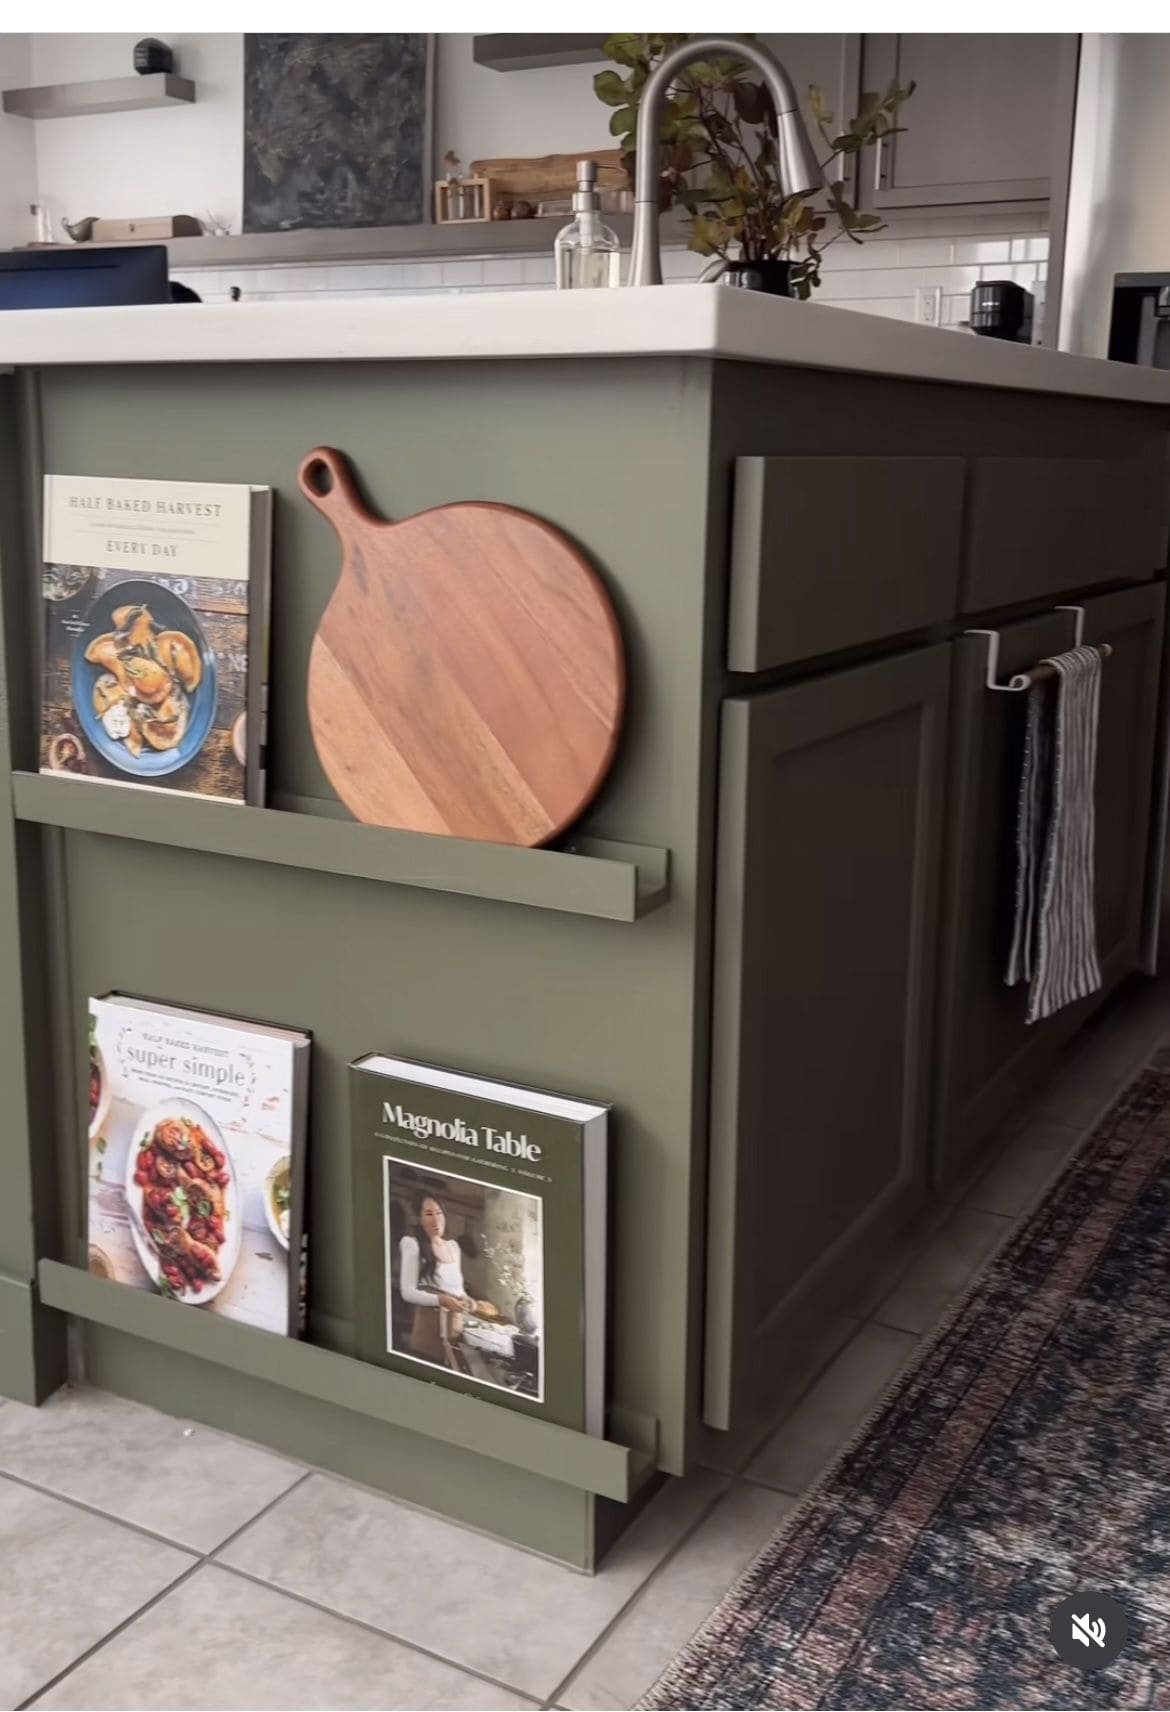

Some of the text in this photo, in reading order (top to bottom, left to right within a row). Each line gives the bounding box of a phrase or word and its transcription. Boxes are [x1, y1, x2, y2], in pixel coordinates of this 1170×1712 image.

[68, 496, 222, 517] HALF BAKED HARVEST
[106, 540, 178, 557] EVERY DAY
[127, 1047, 176, 1070] super
[183, 1056, 246, 1087] simple
[382, 1101, 479, 1147] Magnolia
[481, 1126, 543, 1162] Table
